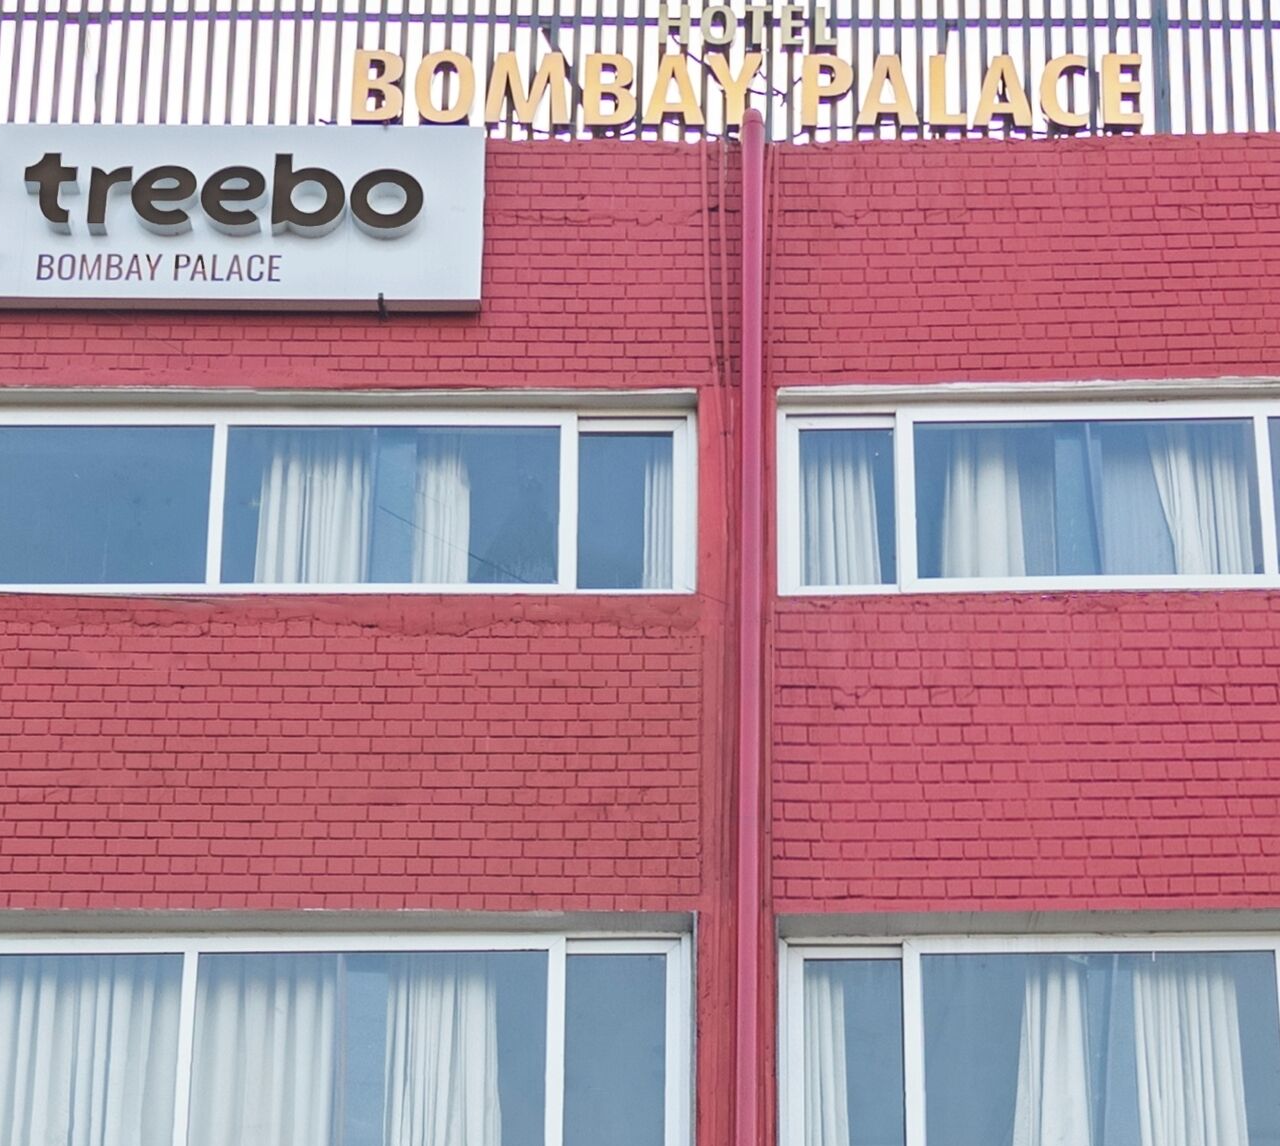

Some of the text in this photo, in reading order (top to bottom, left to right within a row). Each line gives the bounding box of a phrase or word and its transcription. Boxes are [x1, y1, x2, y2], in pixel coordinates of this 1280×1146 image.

[658, 4, 838, 46] HOTEL
[351, 48, 1144, 128] BOMBAY PALACE
[24, 152, 424, 236] treebo
[36, 253, 282, 282] BOMBAY PALACE
